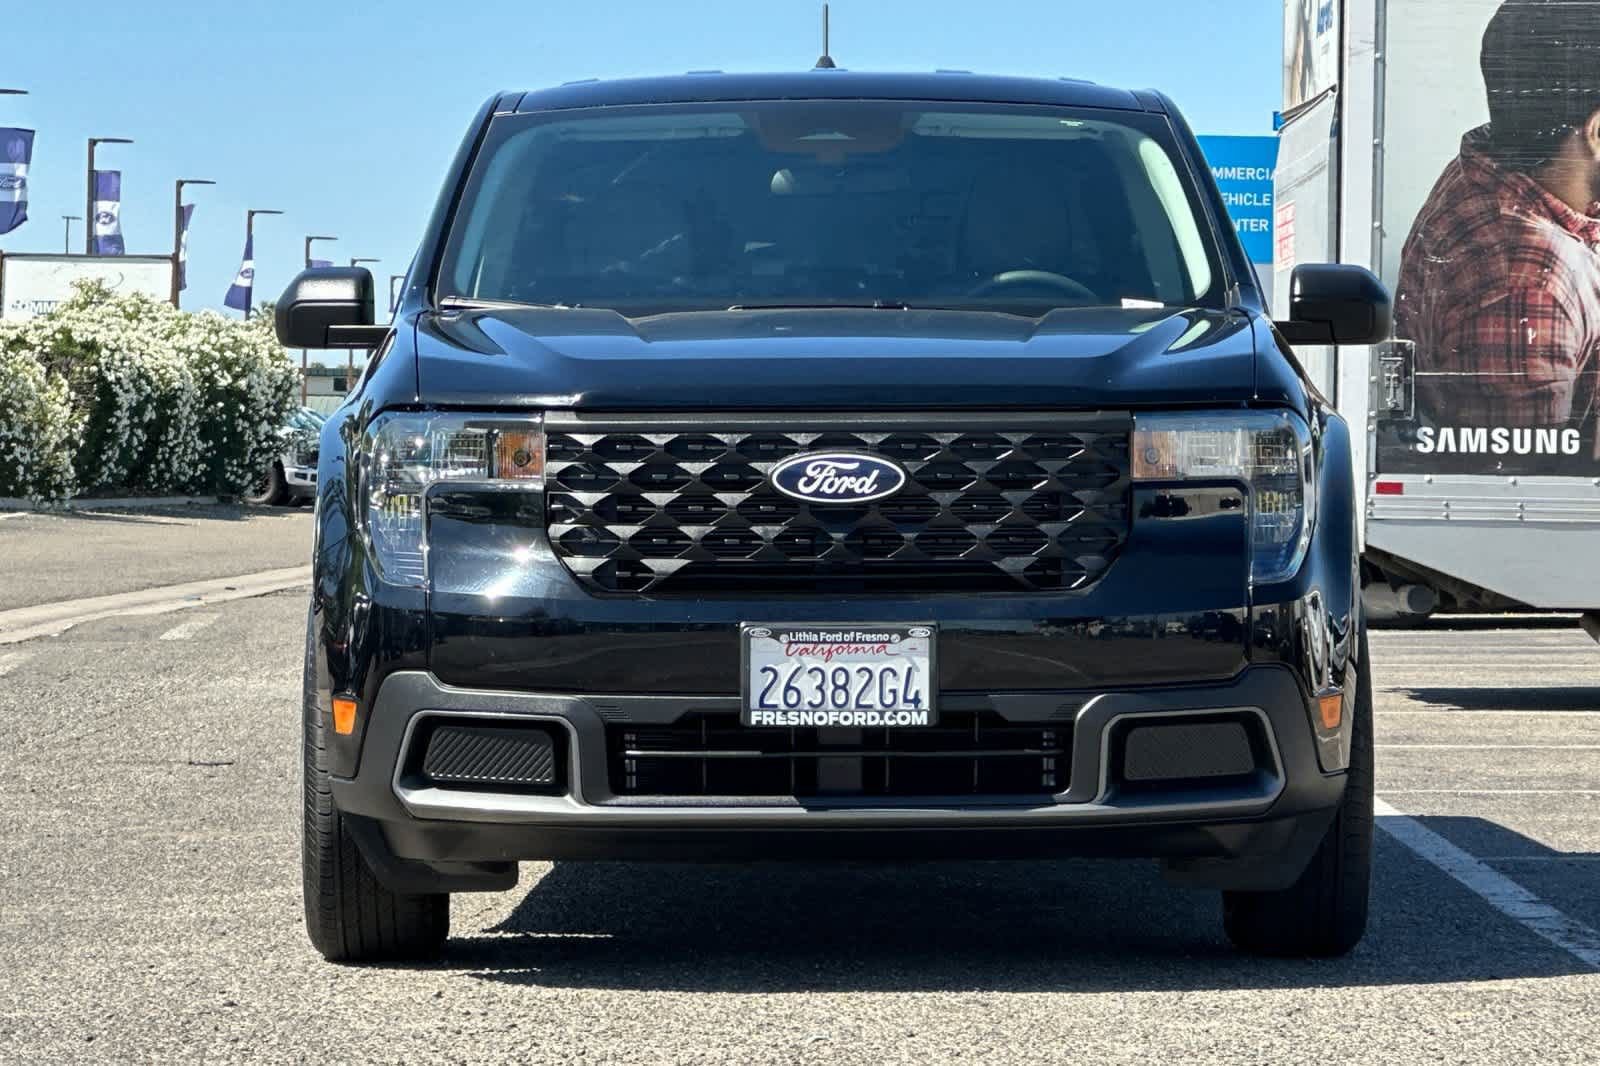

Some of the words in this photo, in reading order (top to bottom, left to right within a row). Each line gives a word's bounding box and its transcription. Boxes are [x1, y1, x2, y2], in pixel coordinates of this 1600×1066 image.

[1212, 167, 1275, 180] MMERCI
[1221, 192, 1272, 206] EHICLE
[1416, 427, 1580, 454] SAMSUNG
[798, 461, 879, 494] Ford
[789, 631, 818, 642] Lithia
[820, 631, 842, 642] Ford
[844, 631, 855, 642] of
[856, 631, 890, 642] Fresno
[785, 642, 900, 663] California
[758, 666, 922, 709] 26382G4
[750, 711, 928, 726] FRESNOFORD.COM
